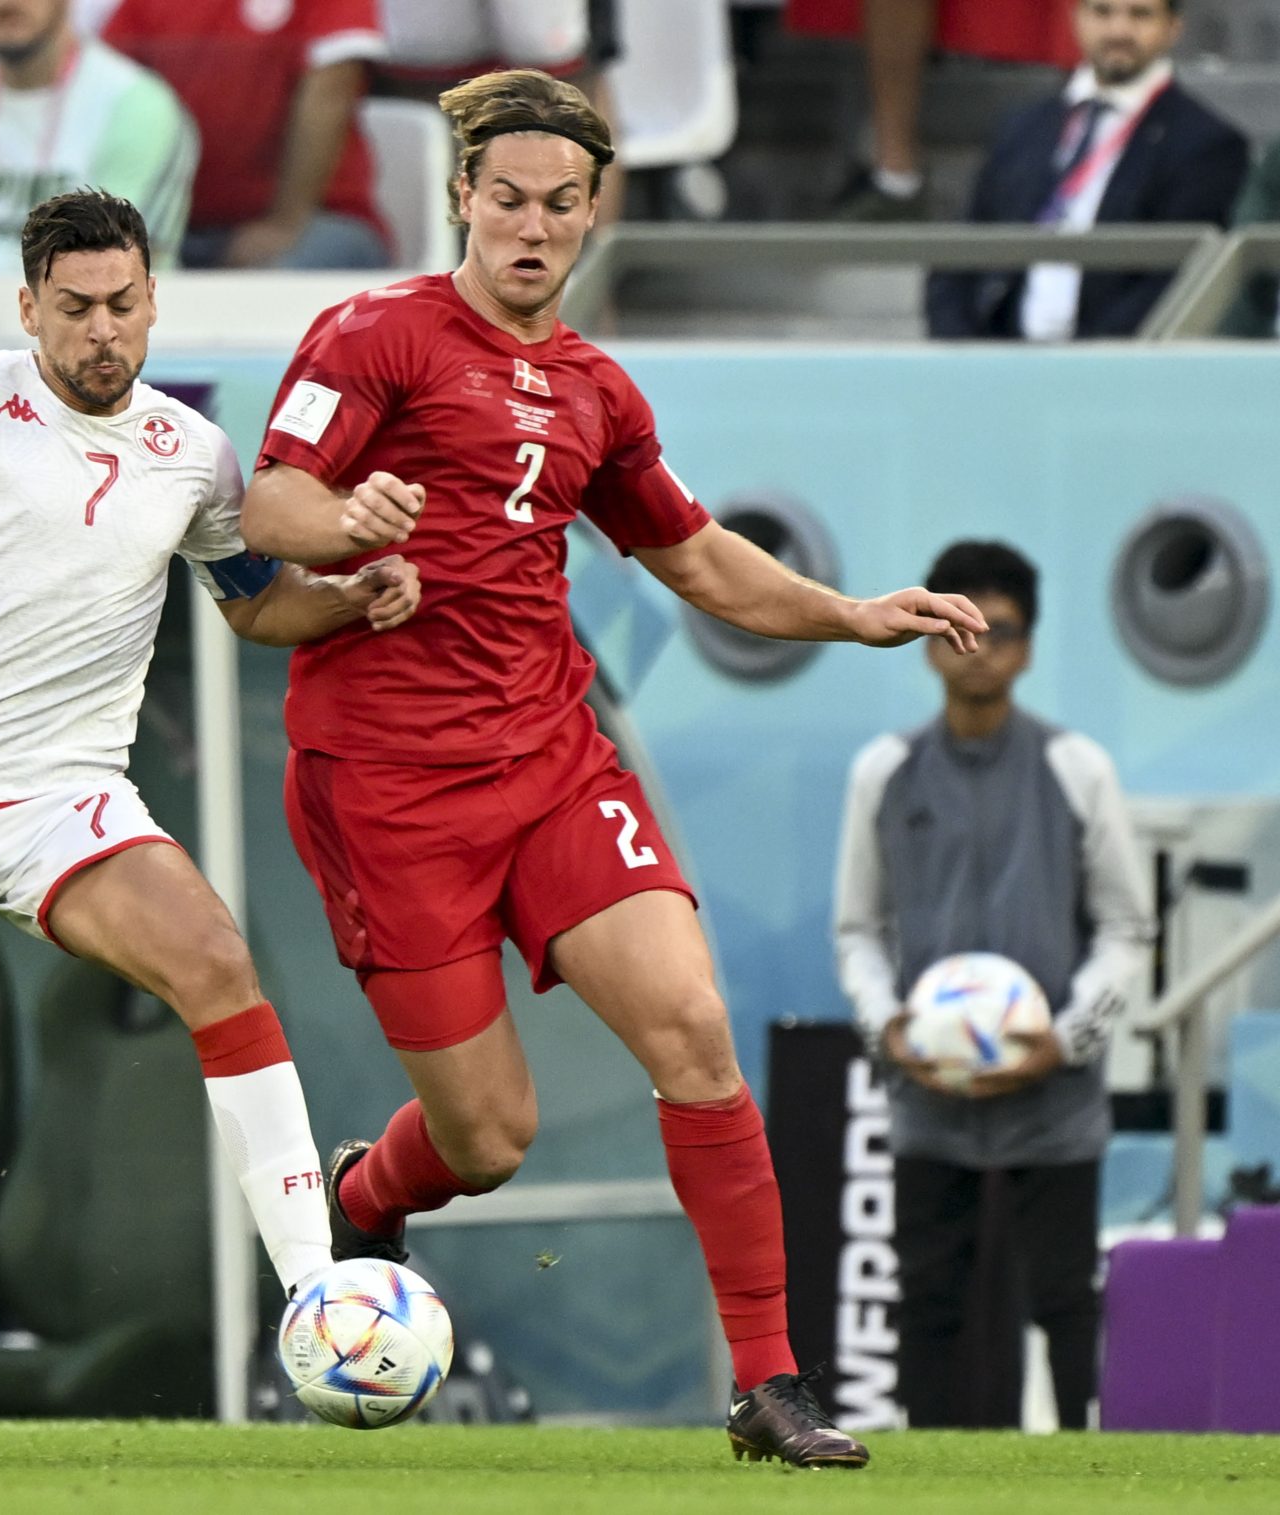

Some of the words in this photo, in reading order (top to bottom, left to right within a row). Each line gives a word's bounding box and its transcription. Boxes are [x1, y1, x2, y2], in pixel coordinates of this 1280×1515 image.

[85, 451, 119, 526] 7
[504, 442, 546, 523] 2
[73, 792, 110, 839] 7
[598, 800, 659, 869] 2
[284, 1170, 323, 1195] FTF
